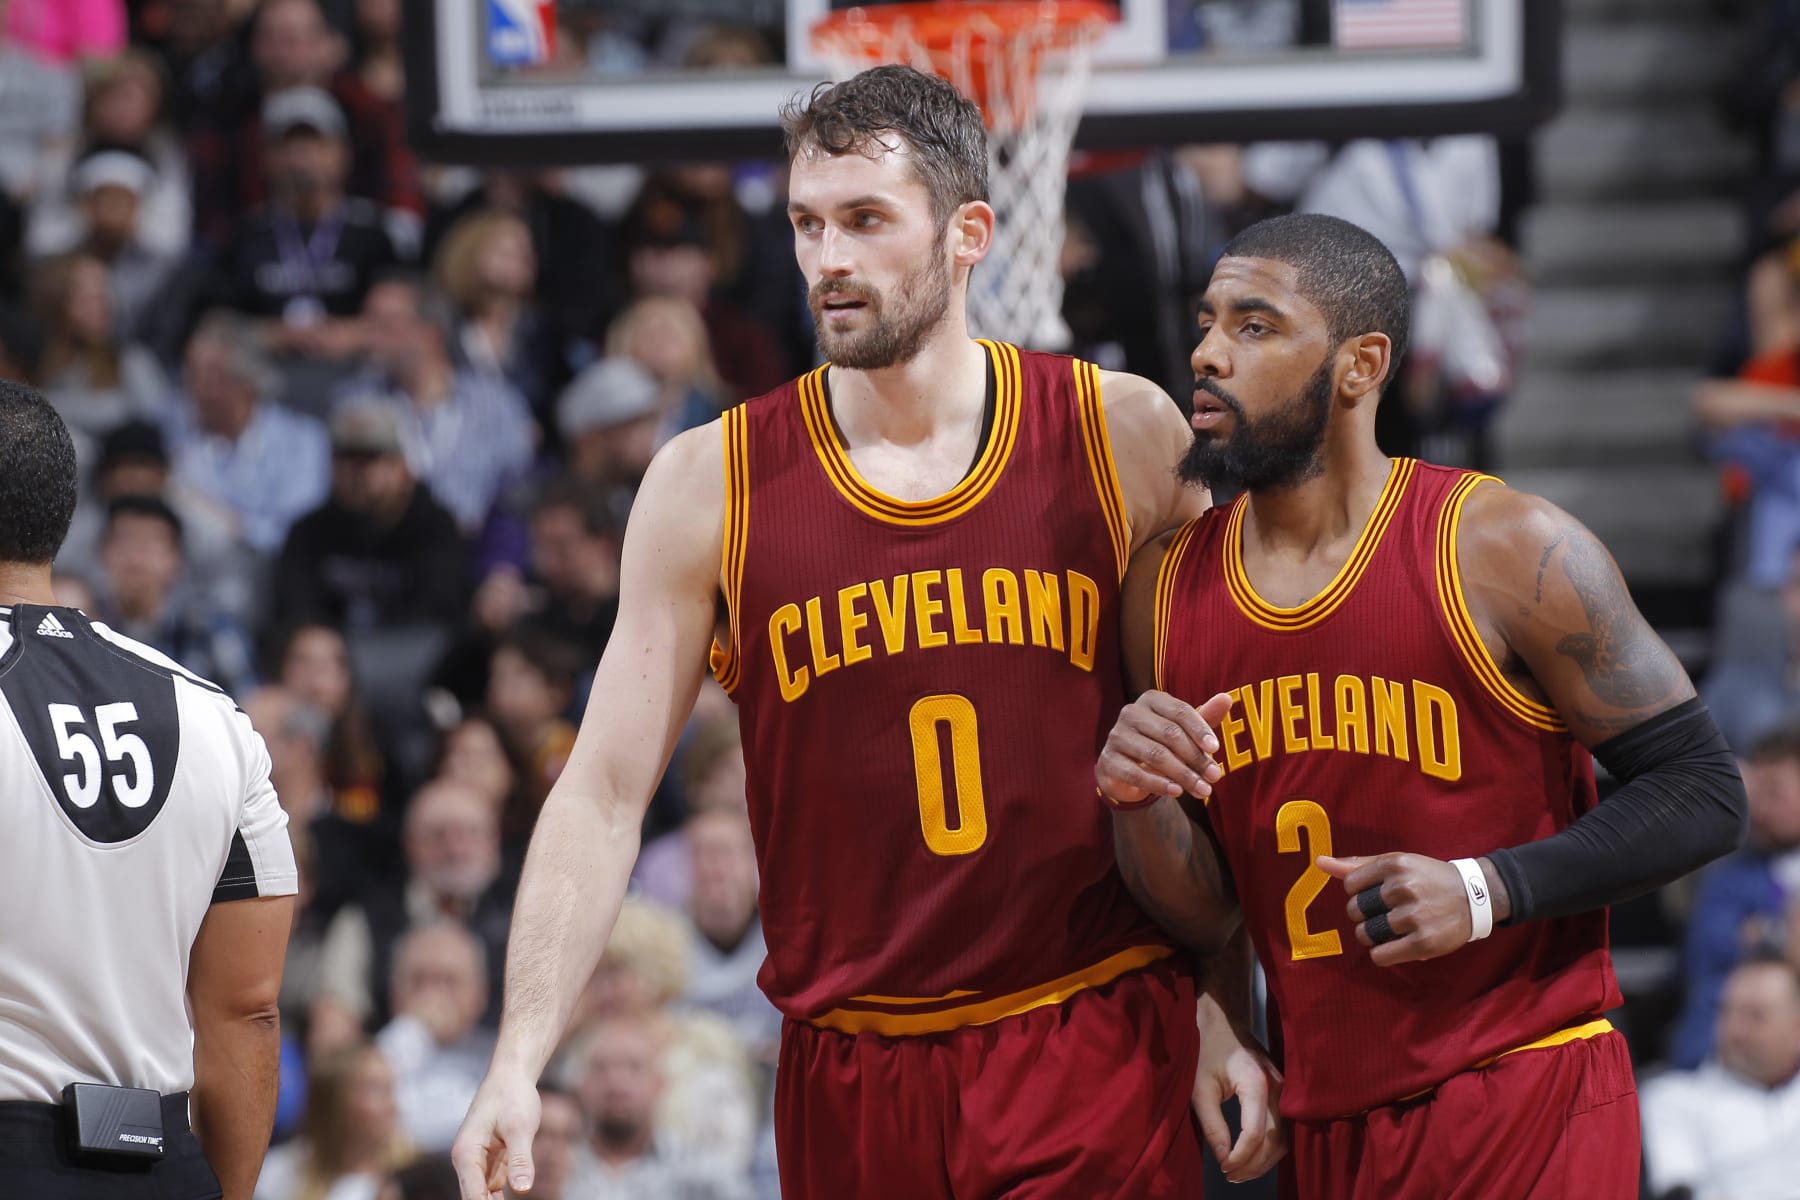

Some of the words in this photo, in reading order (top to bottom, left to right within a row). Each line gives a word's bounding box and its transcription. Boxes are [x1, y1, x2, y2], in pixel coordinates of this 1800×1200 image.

[36, 628, 74, 639] adidas
[769, 568, 1100, 703] CLEVELAND
[48, 702, 154, 809] 55
[909, 694, 987, 856] 0
[1195, 672, 1461, 806] EVELAND
[1276, 800, 1343, 961] 2
[119, 1133, 147, 1144] PRECISION
